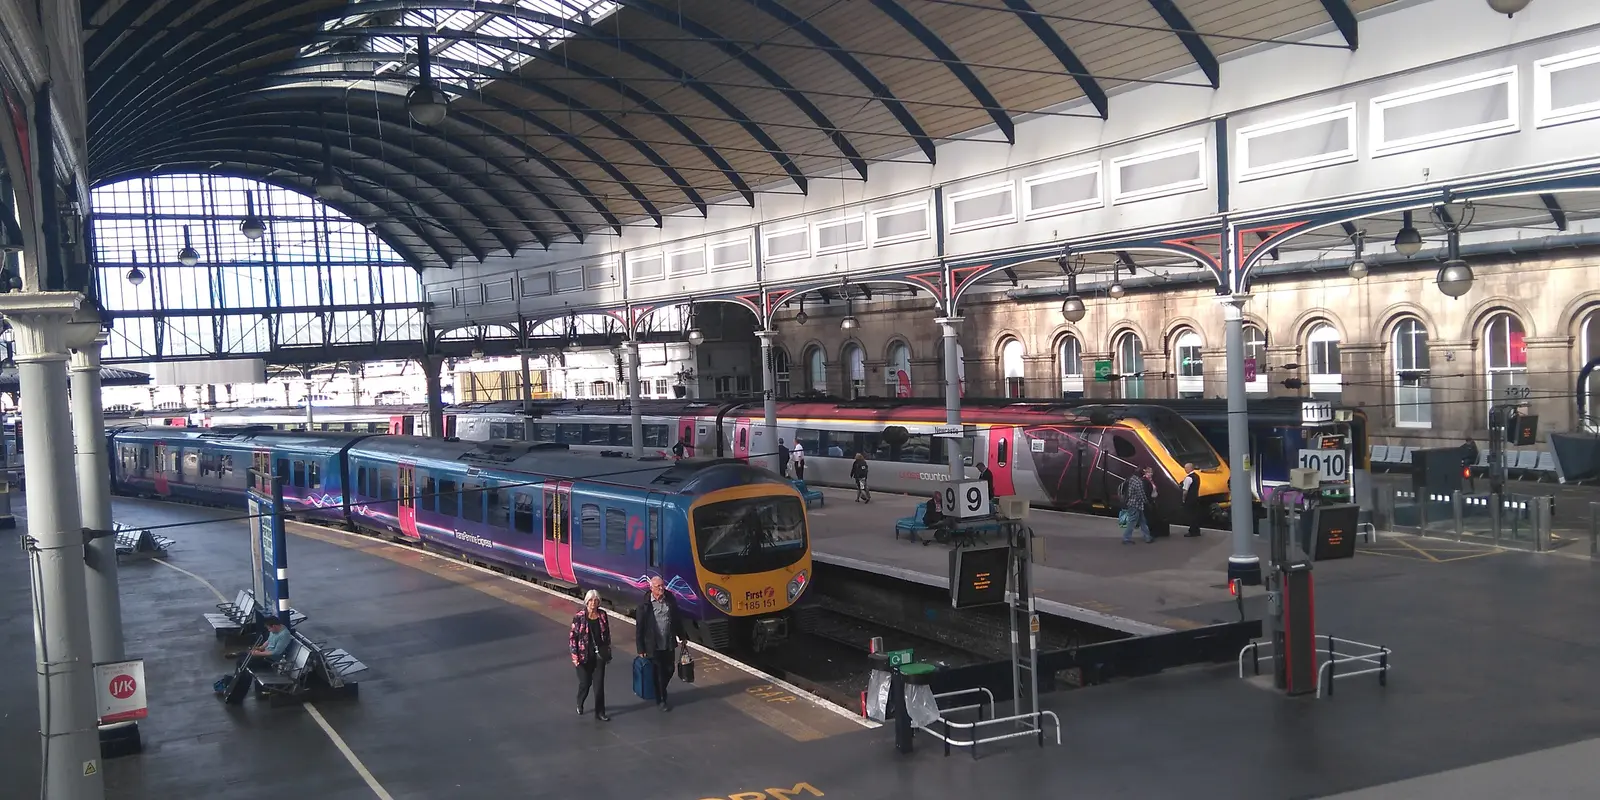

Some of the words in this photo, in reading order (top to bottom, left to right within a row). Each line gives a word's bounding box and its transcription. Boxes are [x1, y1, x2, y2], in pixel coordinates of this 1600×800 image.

[1520, 387, 1530, 399] 12
[1304, 405, 1316, 418] 11
[1319, 404, 1329, 418] 11
[1300, 454, 1320, 470] 10
[1323, 454, 1344, 477] 10
[945, 487, 956, 512] 9
[966, 487, 982, 511] 9
[745, 590, 763, 600] First
[744, 600, 760, 611] 185
[763, 599, 776, 608] 151
[113, 679, 134, 695] J/K
[746, 684, 797, 703] GAP
